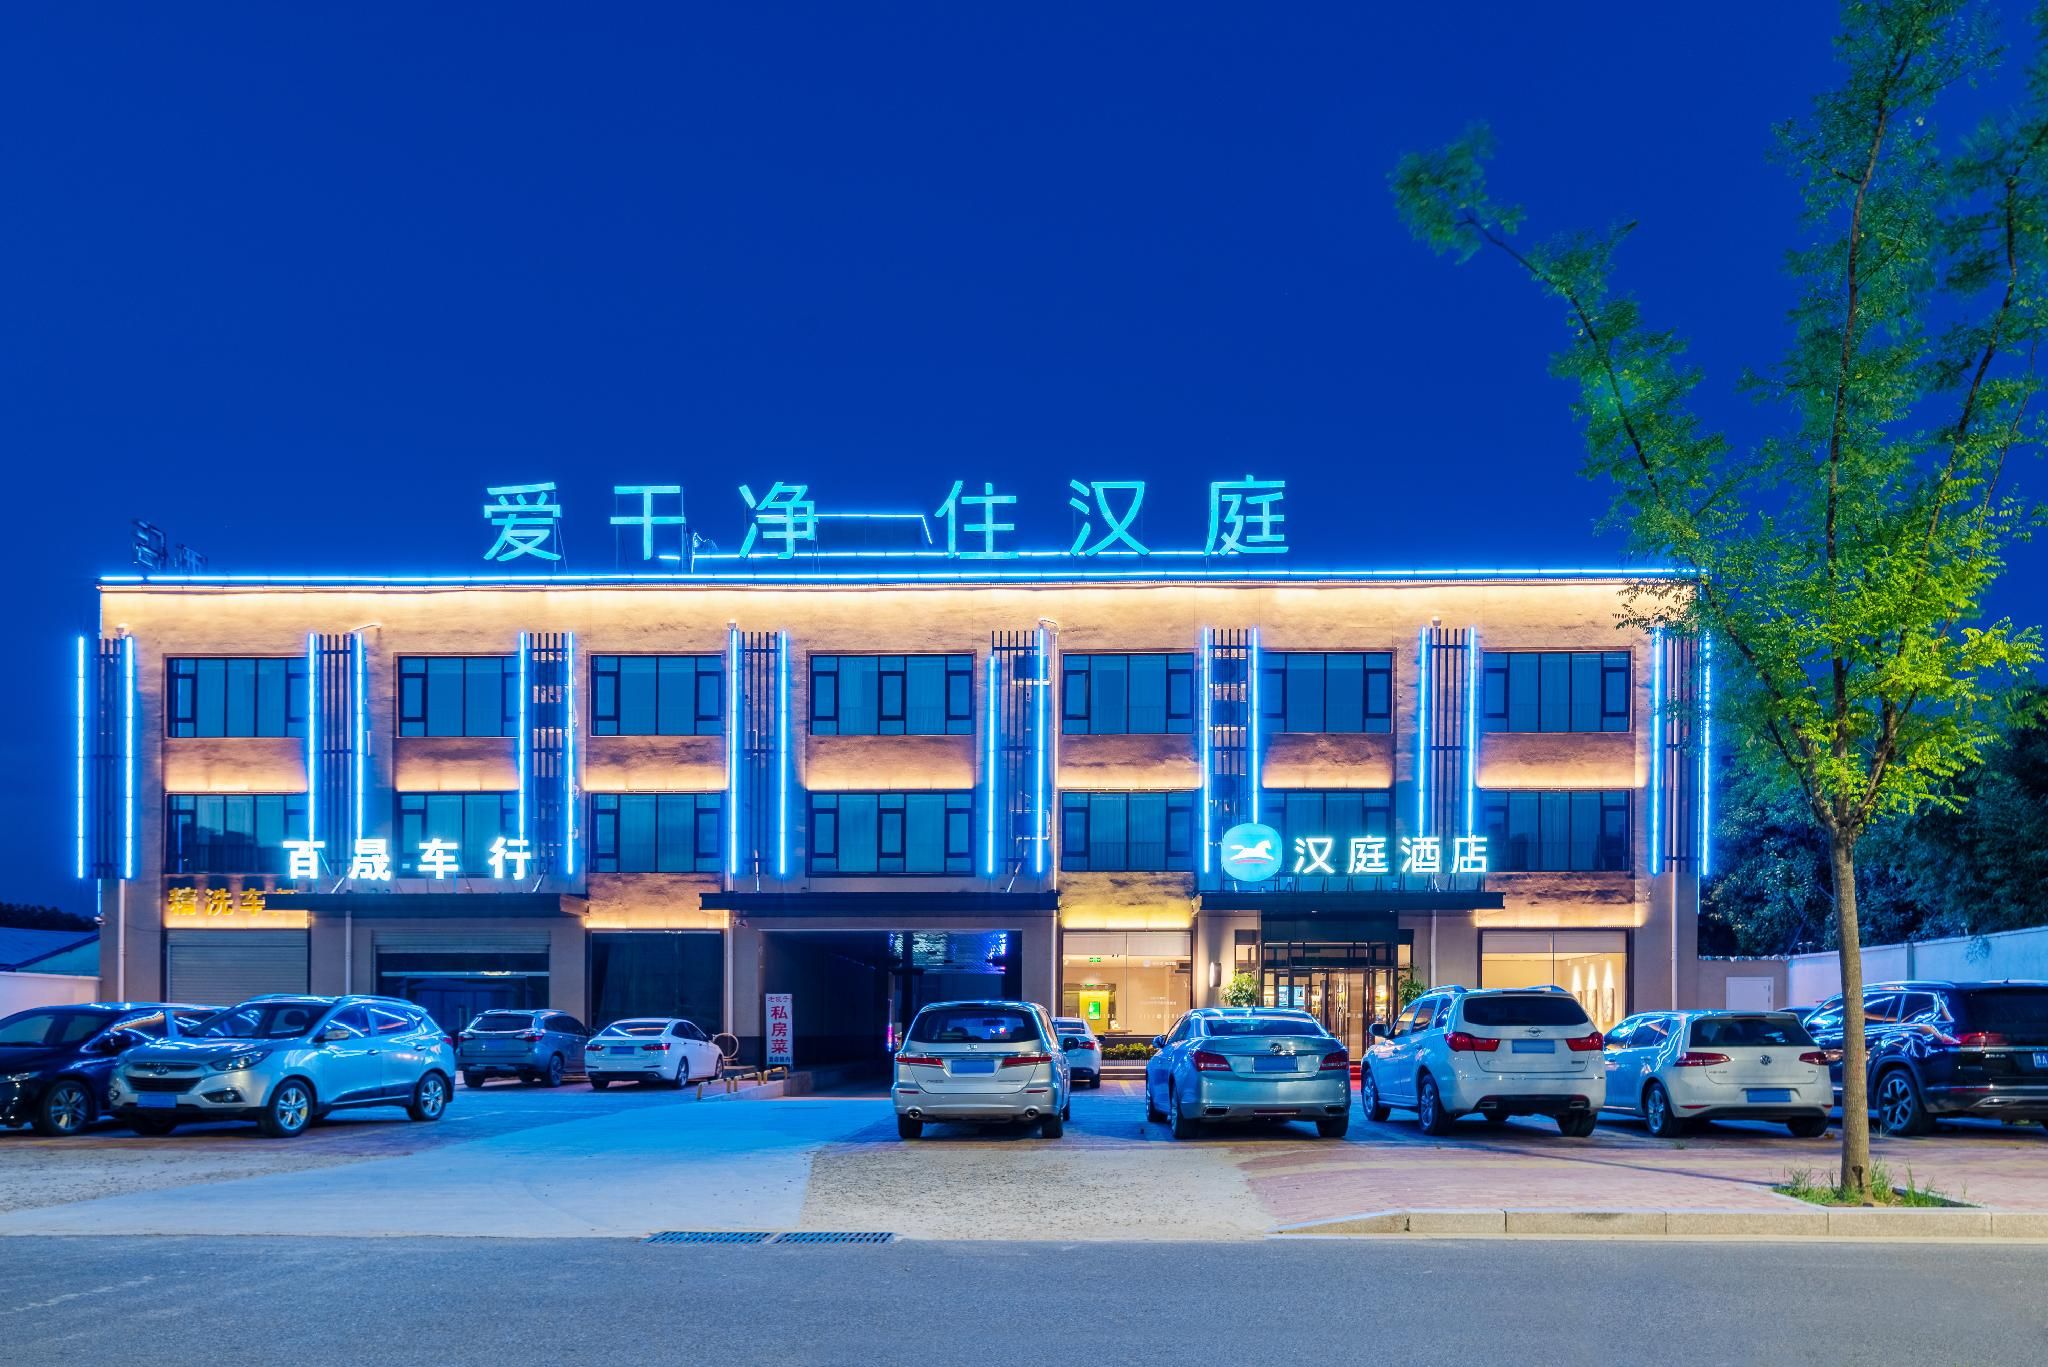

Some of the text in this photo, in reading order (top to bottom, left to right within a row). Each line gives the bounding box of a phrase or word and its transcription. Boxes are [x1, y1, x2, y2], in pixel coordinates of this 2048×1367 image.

[483, 474, 1290, 562] 爱干净 住汉庭
[282, 837, 532, 881] 百晟车行
[1294, 834, 1488, 874] 汉庭酒店
[167, 886, 300, 917] 精洗车
[770, 1005, 789, 1054] 私房菜
